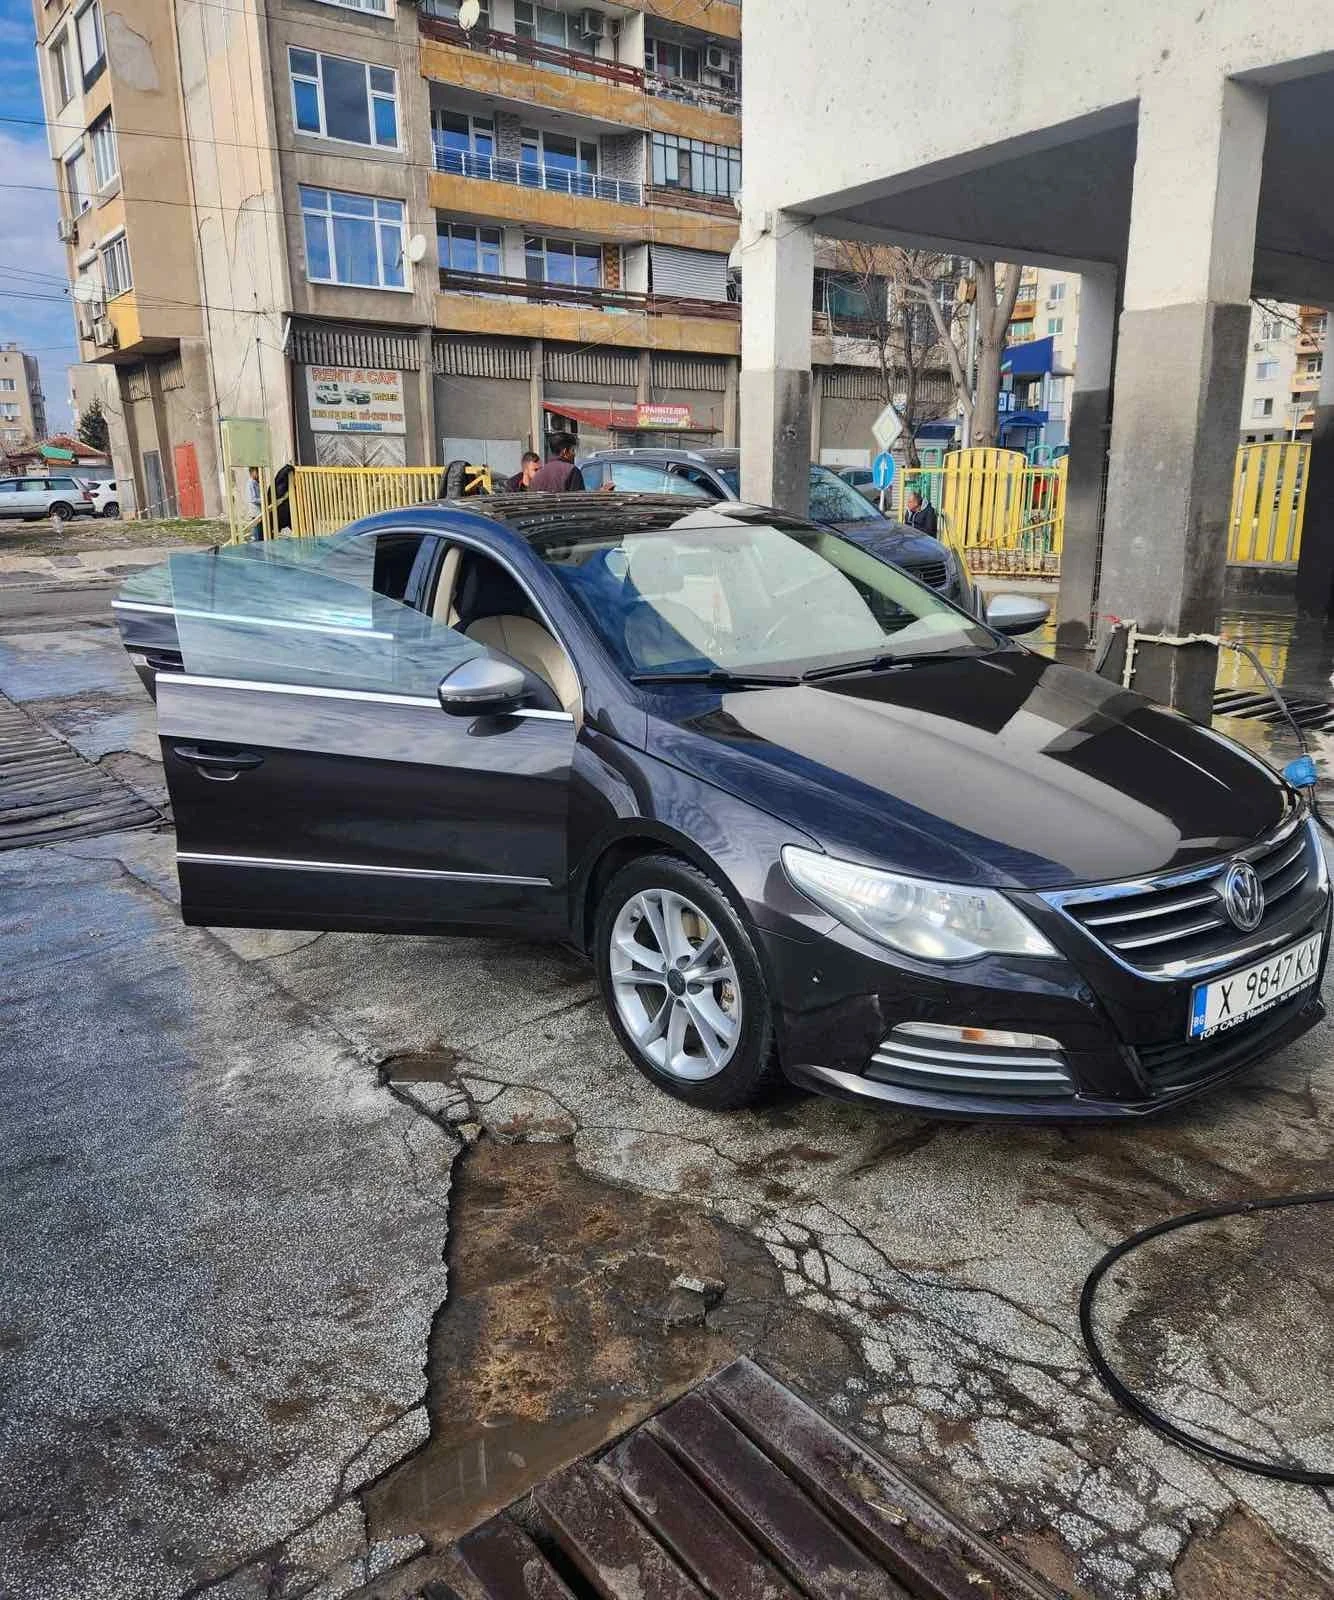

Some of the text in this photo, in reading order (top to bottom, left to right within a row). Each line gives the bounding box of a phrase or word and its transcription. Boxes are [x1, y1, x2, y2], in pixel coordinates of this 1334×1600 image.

[312, 368, 352, 382] RENT
[367, 371, 397, 384] CAR
[1200, 1024, 1220, 1040] TOP
[1220, 1011, 1247, 1031] CARS
